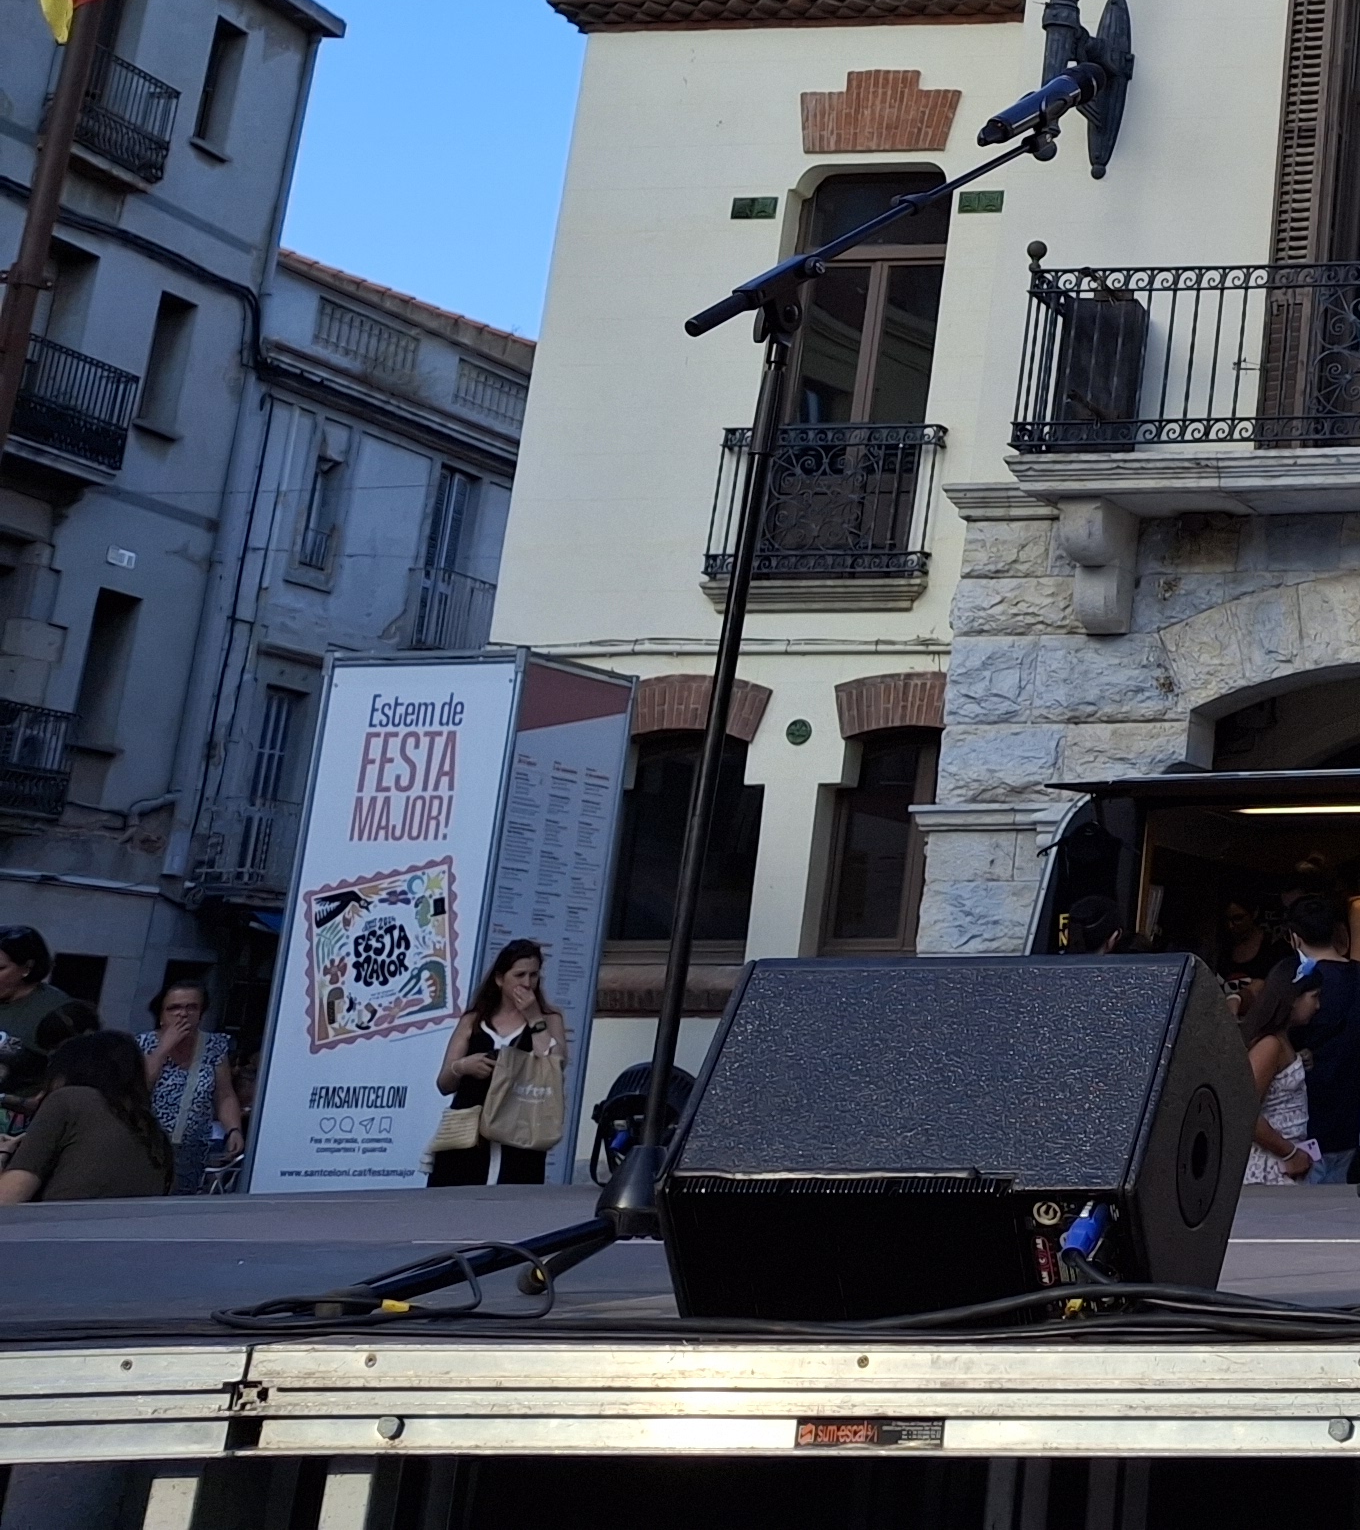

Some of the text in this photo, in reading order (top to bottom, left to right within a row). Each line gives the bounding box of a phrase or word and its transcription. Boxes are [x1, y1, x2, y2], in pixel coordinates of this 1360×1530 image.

[368, 691, 465, 728] Estem de
[356, 730, 457, 793] FESTA
[349, 795, 454, 842] MAJOR!
[353, 924, 411, 958] FESTA
[352, 952, 409, 987] MAJOR
[308, 1085, 408, 1109] #FMSANTCELONI
[280, 1168, 416, 1178] www.santceloni.cat/festamajor
